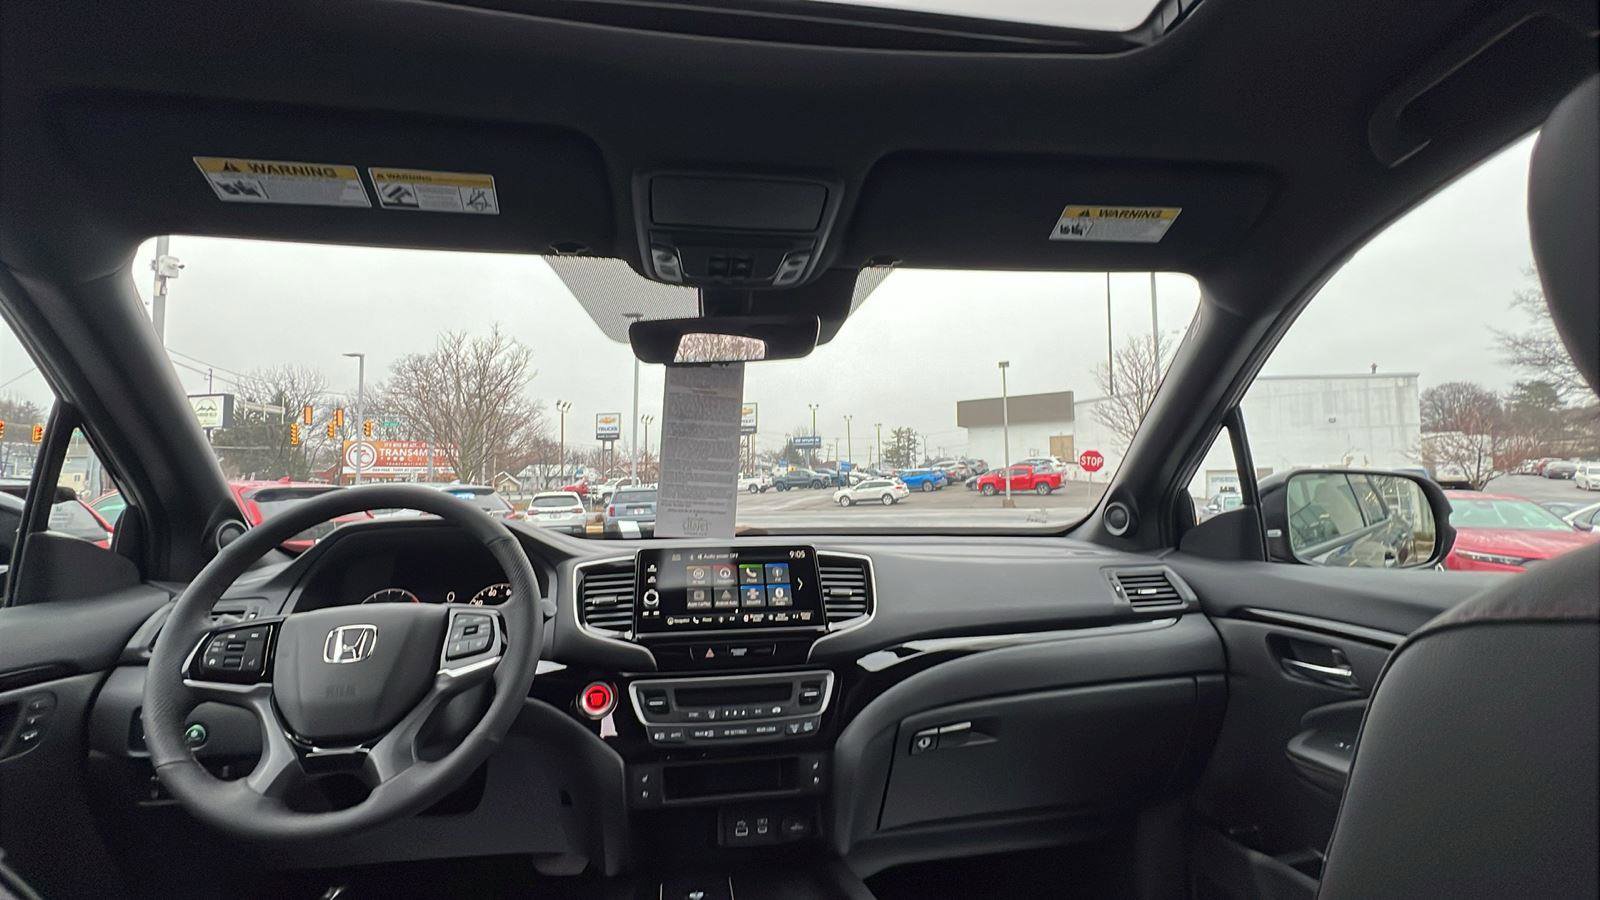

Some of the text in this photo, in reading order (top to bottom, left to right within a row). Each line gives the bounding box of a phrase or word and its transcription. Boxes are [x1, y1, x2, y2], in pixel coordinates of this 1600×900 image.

[246, 162, 337, 178] WARNING
[1099, 208, 1162, 220] WARNING
[1080, 455, 1103, 468] STOP
[789, 550, 805, 559] 9:05
